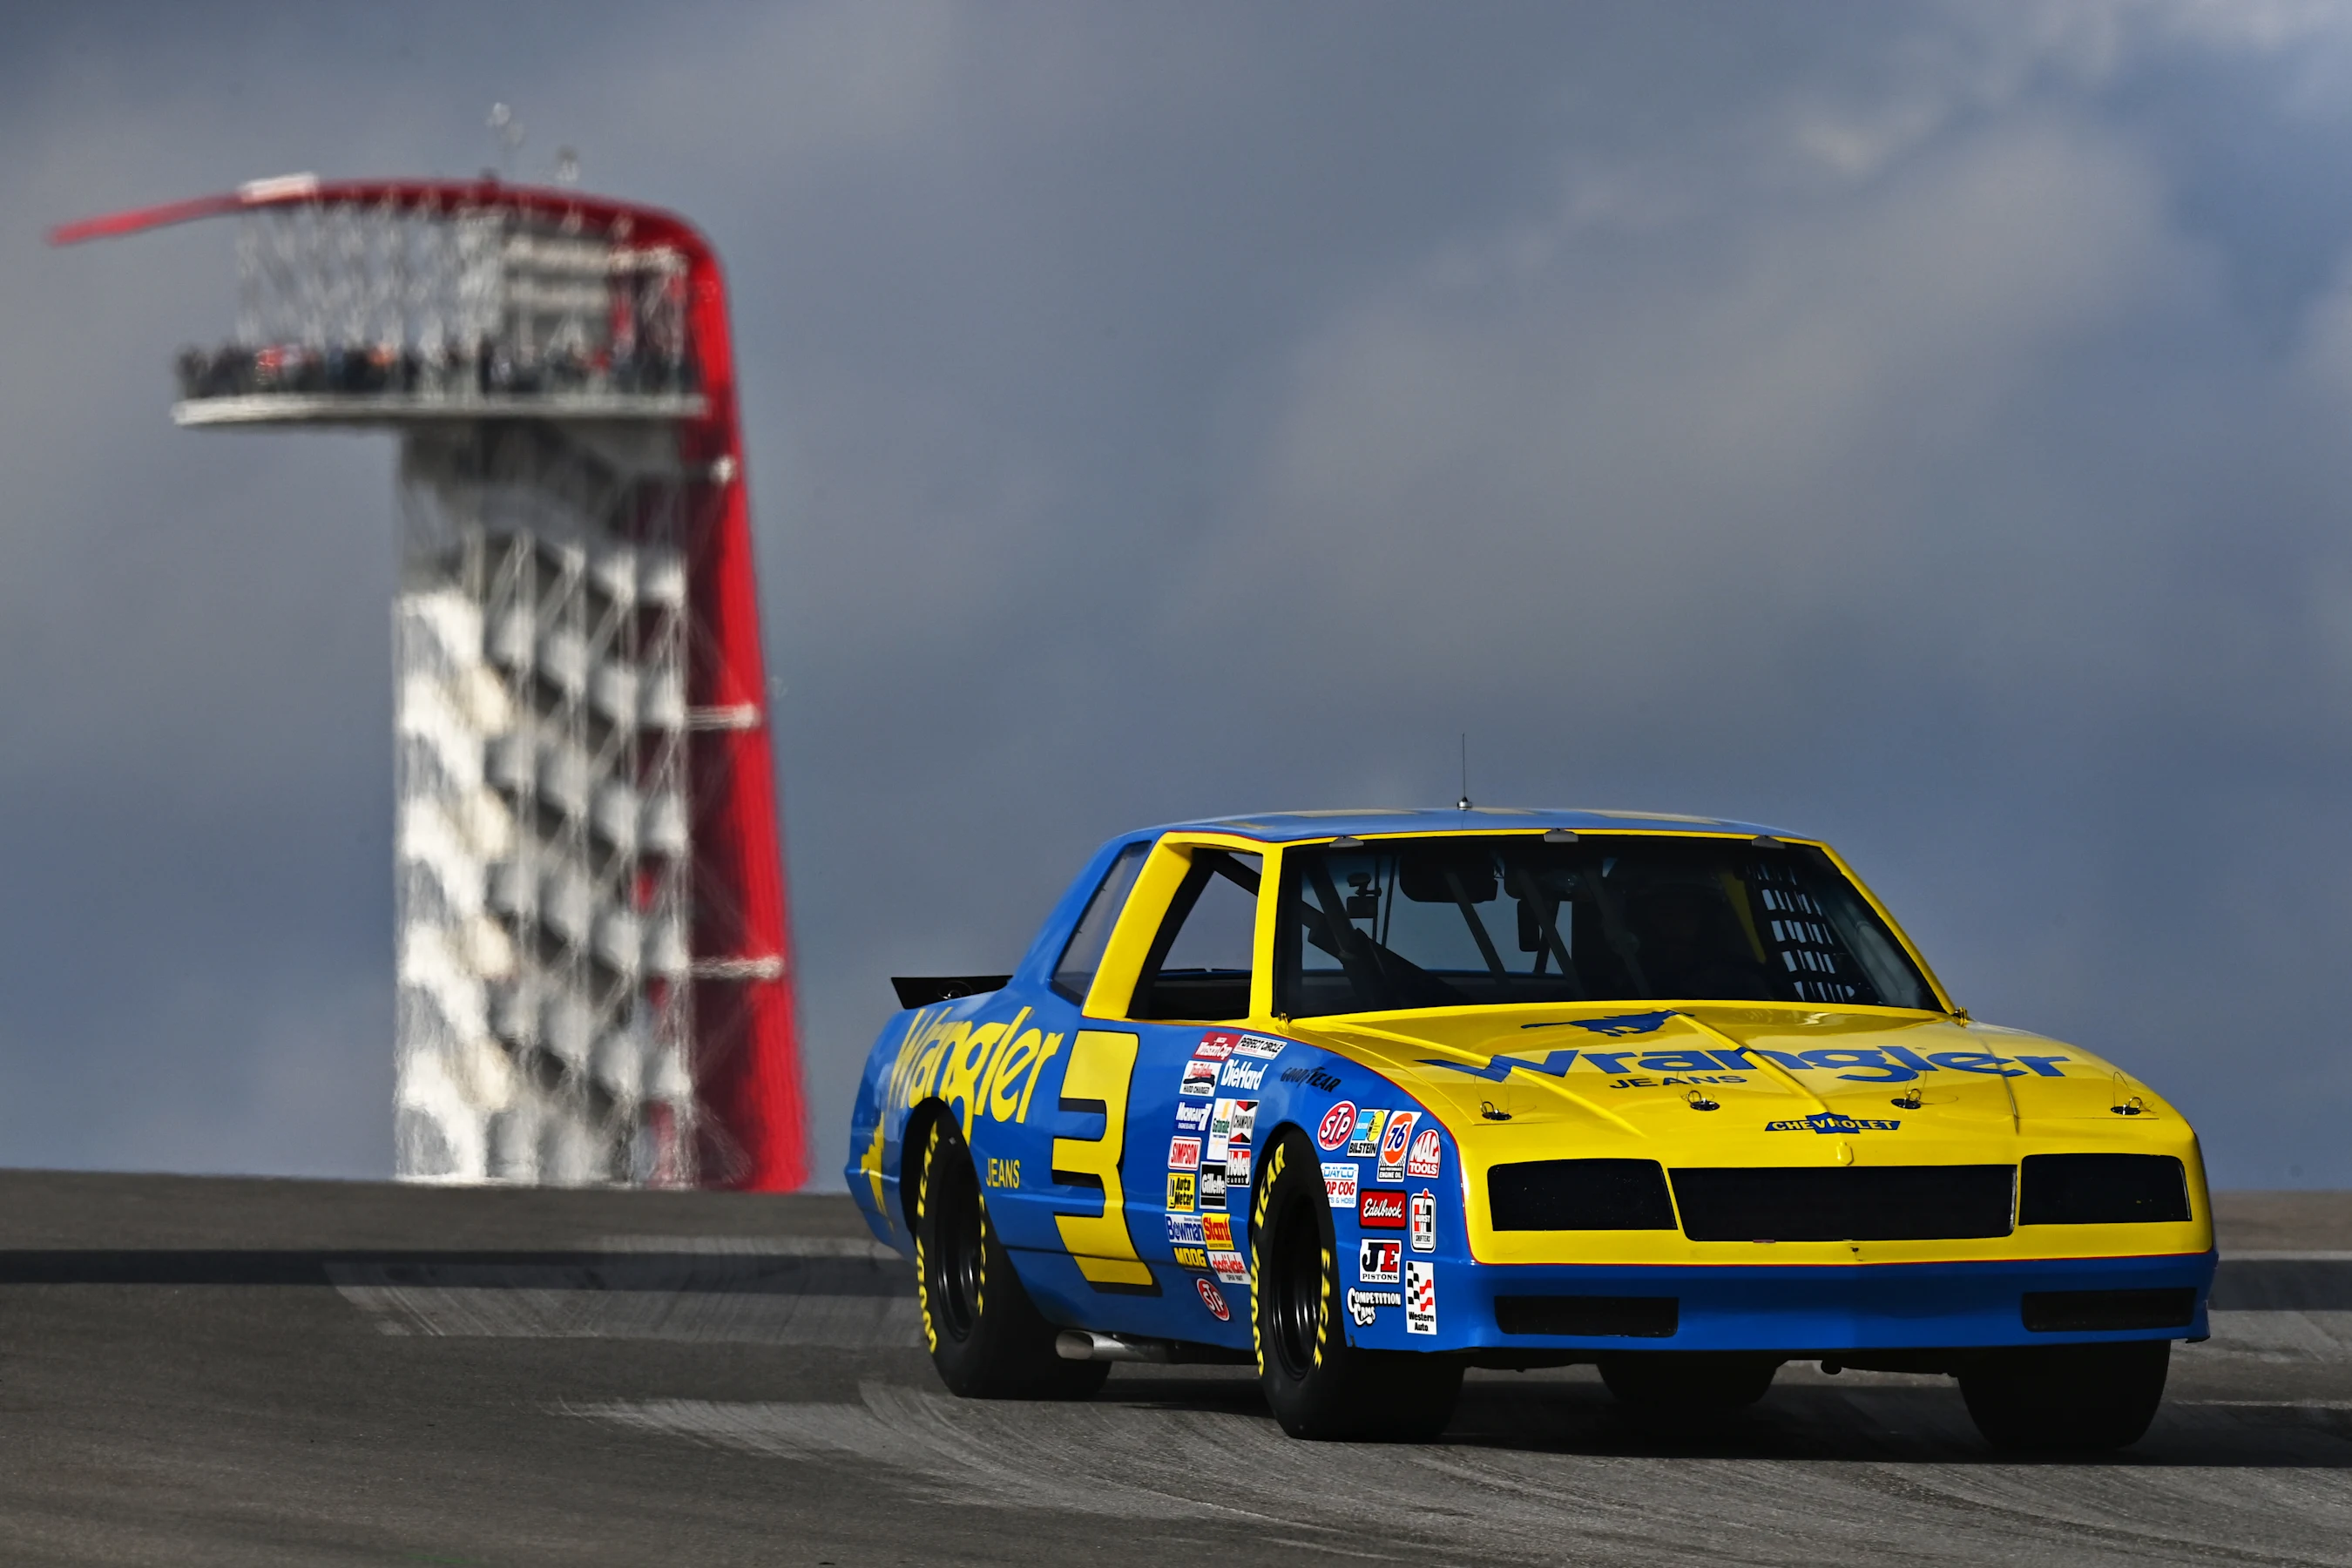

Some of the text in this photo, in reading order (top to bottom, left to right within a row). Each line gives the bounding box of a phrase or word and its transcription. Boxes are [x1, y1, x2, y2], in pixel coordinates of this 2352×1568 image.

[1240, 1037, 1263, 1050] PERFECT
[1260, 1040, 1284, 1053] CIRCLE
[887, 1006, 1064, 1146] Wrangler
[1220, 1058, 1268, 1091] DieHard
[1610, 1075, 1747, 1089] JEANS
[1233, 1115, 1254, 1129] CHAMPION
[1321, 1107, 1351, 1140] STP
[1772, 1118, 1893, 1130] CHEVROLET
[1386, 1123, 1409, 1151] 76
[1409, 1132, 1439, 1163] MAC
[1051, 1031, 1153, 1286] 3
[1171, 1143, 1199, 1165] SIMPSON
[1348, 1143, 1377, 1154] BILSTEIN
[986, 1158, 1020, 1189] JEANS
[1227, 1151, 1250, 1184] Holley
[1324, 1166, 1355, 1178] DAYCO
[1409, 1163, 1437, 1174] TOOLS
[1176, 1177, 1191, 1191] Auto
[1201, 1173, 1226, 1194] Gillette
[1325, 1181, 1355, 1195] OP COG
[1174, 1192, 1193, 1206] Meter
[1363, 1198, 1403, 1219] Edelbrock
[1166, 1215, 1203, 1241] Bowman
[1203, 1217, 1232, 1240] Stant
[1173, 1247, 1207, 1267] MOOG
[1362, 1242, 1399, 1273] JE
[1202, 1283, 1224, 1313] STP
[1348, 1288, 1401, 1313] COMPETITION
[1354, 1303, 1375, 1325] CAMS
[1409, 1311, 1435, 1322] Western
[1414, 1321, 1429, 1331] Auto
